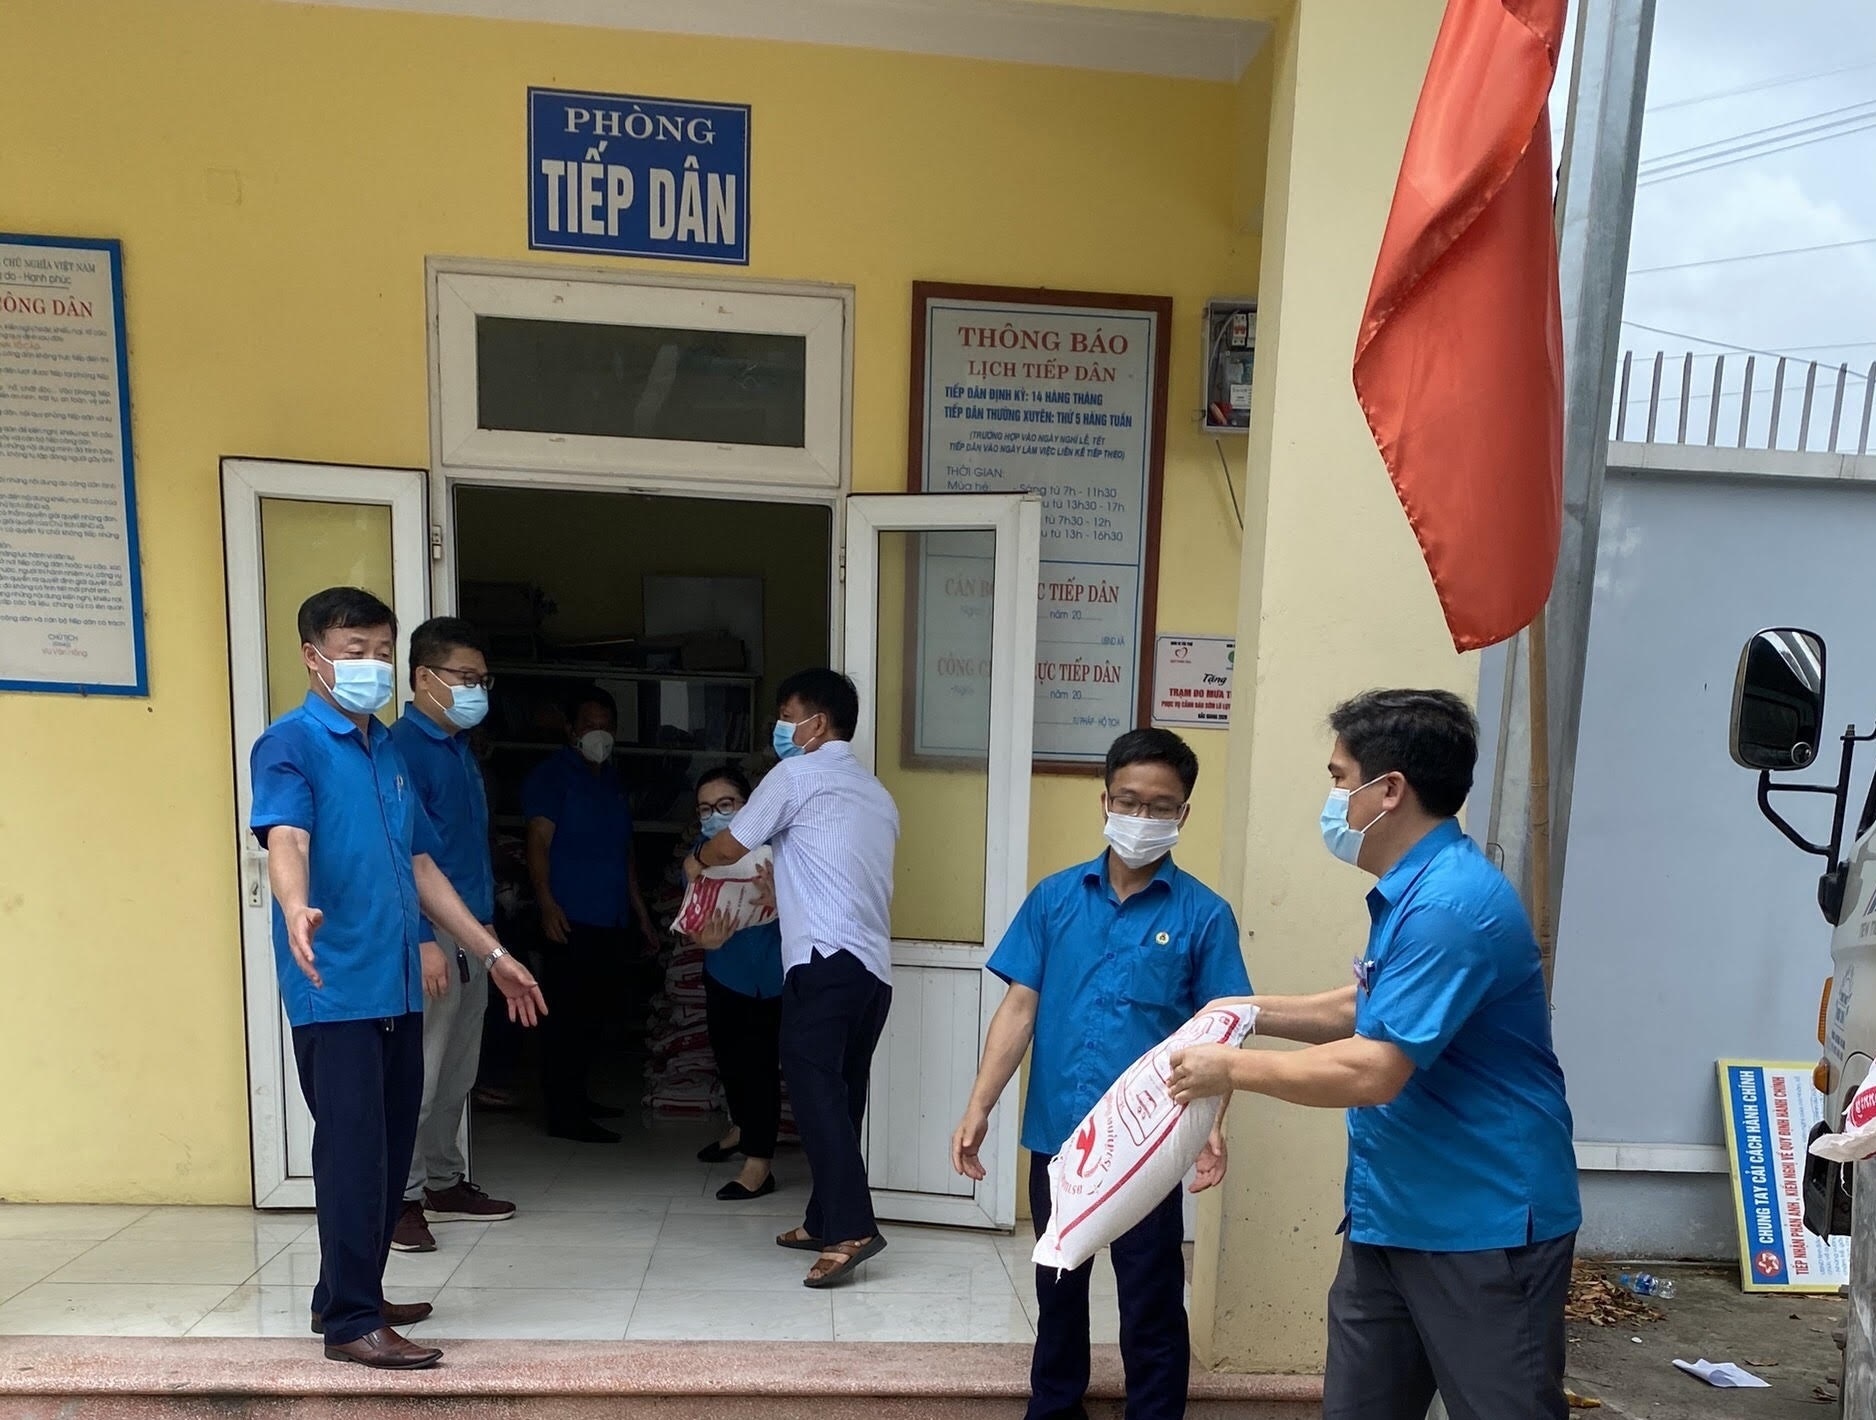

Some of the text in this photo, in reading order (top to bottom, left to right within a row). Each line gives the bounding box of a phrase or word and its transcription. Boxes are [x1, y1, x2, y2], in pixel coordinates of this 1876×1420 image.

[564, 105, 716, 144] PHÒNG
[542, 141, 736, 245] TIẾP DÂN
[24, 258, 52, 270] NGHĨA
[54, 260, 74, 272] VIỆT
[77, 262, 95, 273] NAM
[0, 291, 93, 318] ÔNG DÂN
[959, 323, 1128, 355] THÔNG BÁO
[968, 358, 1116, 382] LỊCH TIẾP DÂN
[945, 383, 965, 398] TIẾP
[967, 385, 986, 400] DÂN
[989, 388, 1012, 402] ĐỊNH
[1032, 391, 1042, 402] 14
[1045, 389, 1070, 404] HÀNG
[1074, 391, 1103, 405] THÁNG
[944, 403, 1132, 427] TIẾP DÂN THƯỜNG XUYÊN: THỨ 5 HÀNG TUẦN
[1005, 432, 1020, 441] HỢP
[1021, 432, 1036, 442] VÀO
[1038, 433, 1059, 443] NGÀY
[950, 440, 965, 451] TIẾP
[966, 442, 981, 452] DÂN
[984, 444, 998, 452] VÀO
[1000, 444, 1021, 454] NGÀY
[1022, 445, 1037, 454] LÀM
[1040, 446, 1055, 456] VIỆC
[1087, 448, 1102, 457] TIẾP
[946, 465, 971, 477] THỜI
[947, 481, 971, 491] Mùa
[1020, 483, 1046, 496] Sáng
[1064, 486, 1076, 496] 7h
[1087, 487, 1117, 498] 11h30
[1068, 500, 1096, 510] 13h30
[1107, 502, 1125, 512] 17h
[1059, 516, 1083, 526] 7h30
[1095, 517, 1110, 527] 12h
[1066, 529, 1082, 539] 13h
[1094, 531, 1123, 541] 16h30
[1049, 576, 1084, 601] TIẾP
[1088, 580, 1119, 603] DÂN
[1050, 610, 1082, 620] năm 20
[1059, 657, 1090, 681] TIẾP
[1094, 659, 1121, 683] DÂN
[1203, 673, 1227, 686] Tặng
[1050, 690, 1081, 700] năm 20
[1169, 688, 1191, 698] TRẠM
[1194, 689, 1204, 697] ĐO
[1207, 689, 1224, 698] MƯA
[1770, 1076, 1787, 1097] CHÍNH
[1773, 1099, 1789, 1118] HÀNH
[1778, 1119, 1792, 1136] ĐỊNH
[1780, 1138, 1794, 1150] QUY
[1738, 1070, 1774, 1244] CHUNG TAY CẢI CÁCH HÀNH CHÍNH
[1776, 1152, 1794, 1160] VỀ
[1783, 1162, 1799, 1178] NGHỊ
[1780, 1181, 1798, 1196] KIẾN
[1787, 1218, 1803, 1237] PHẢN
[1789, 1239, 1808, 1258] NHẬN
[1790, 1260, 1809, 1275] TIẾP
